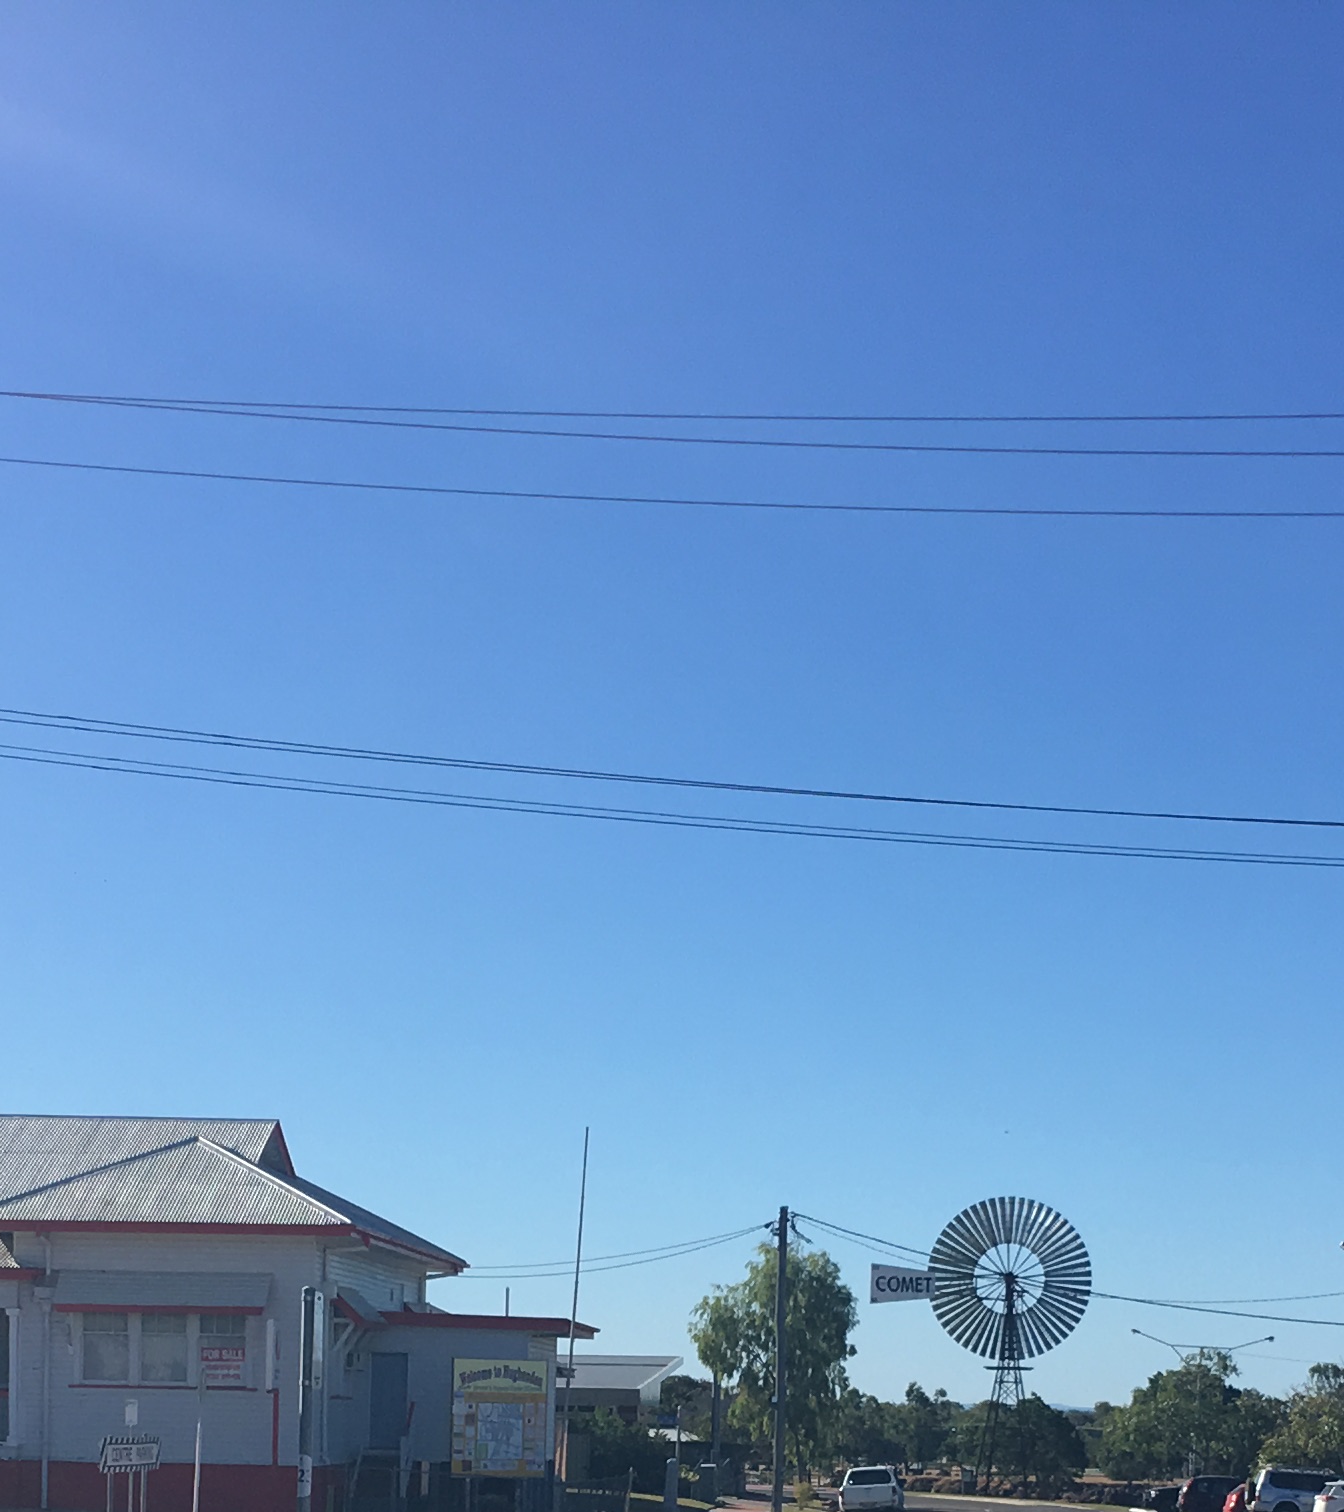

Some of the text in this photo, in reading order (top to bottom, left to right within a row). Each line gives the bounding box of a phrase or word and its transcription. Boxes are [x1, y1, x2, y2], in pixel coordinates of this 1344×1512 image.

[875, 1275, 932, 1293] COMET
[203, 1349, 243, 1359] FOR SALE
